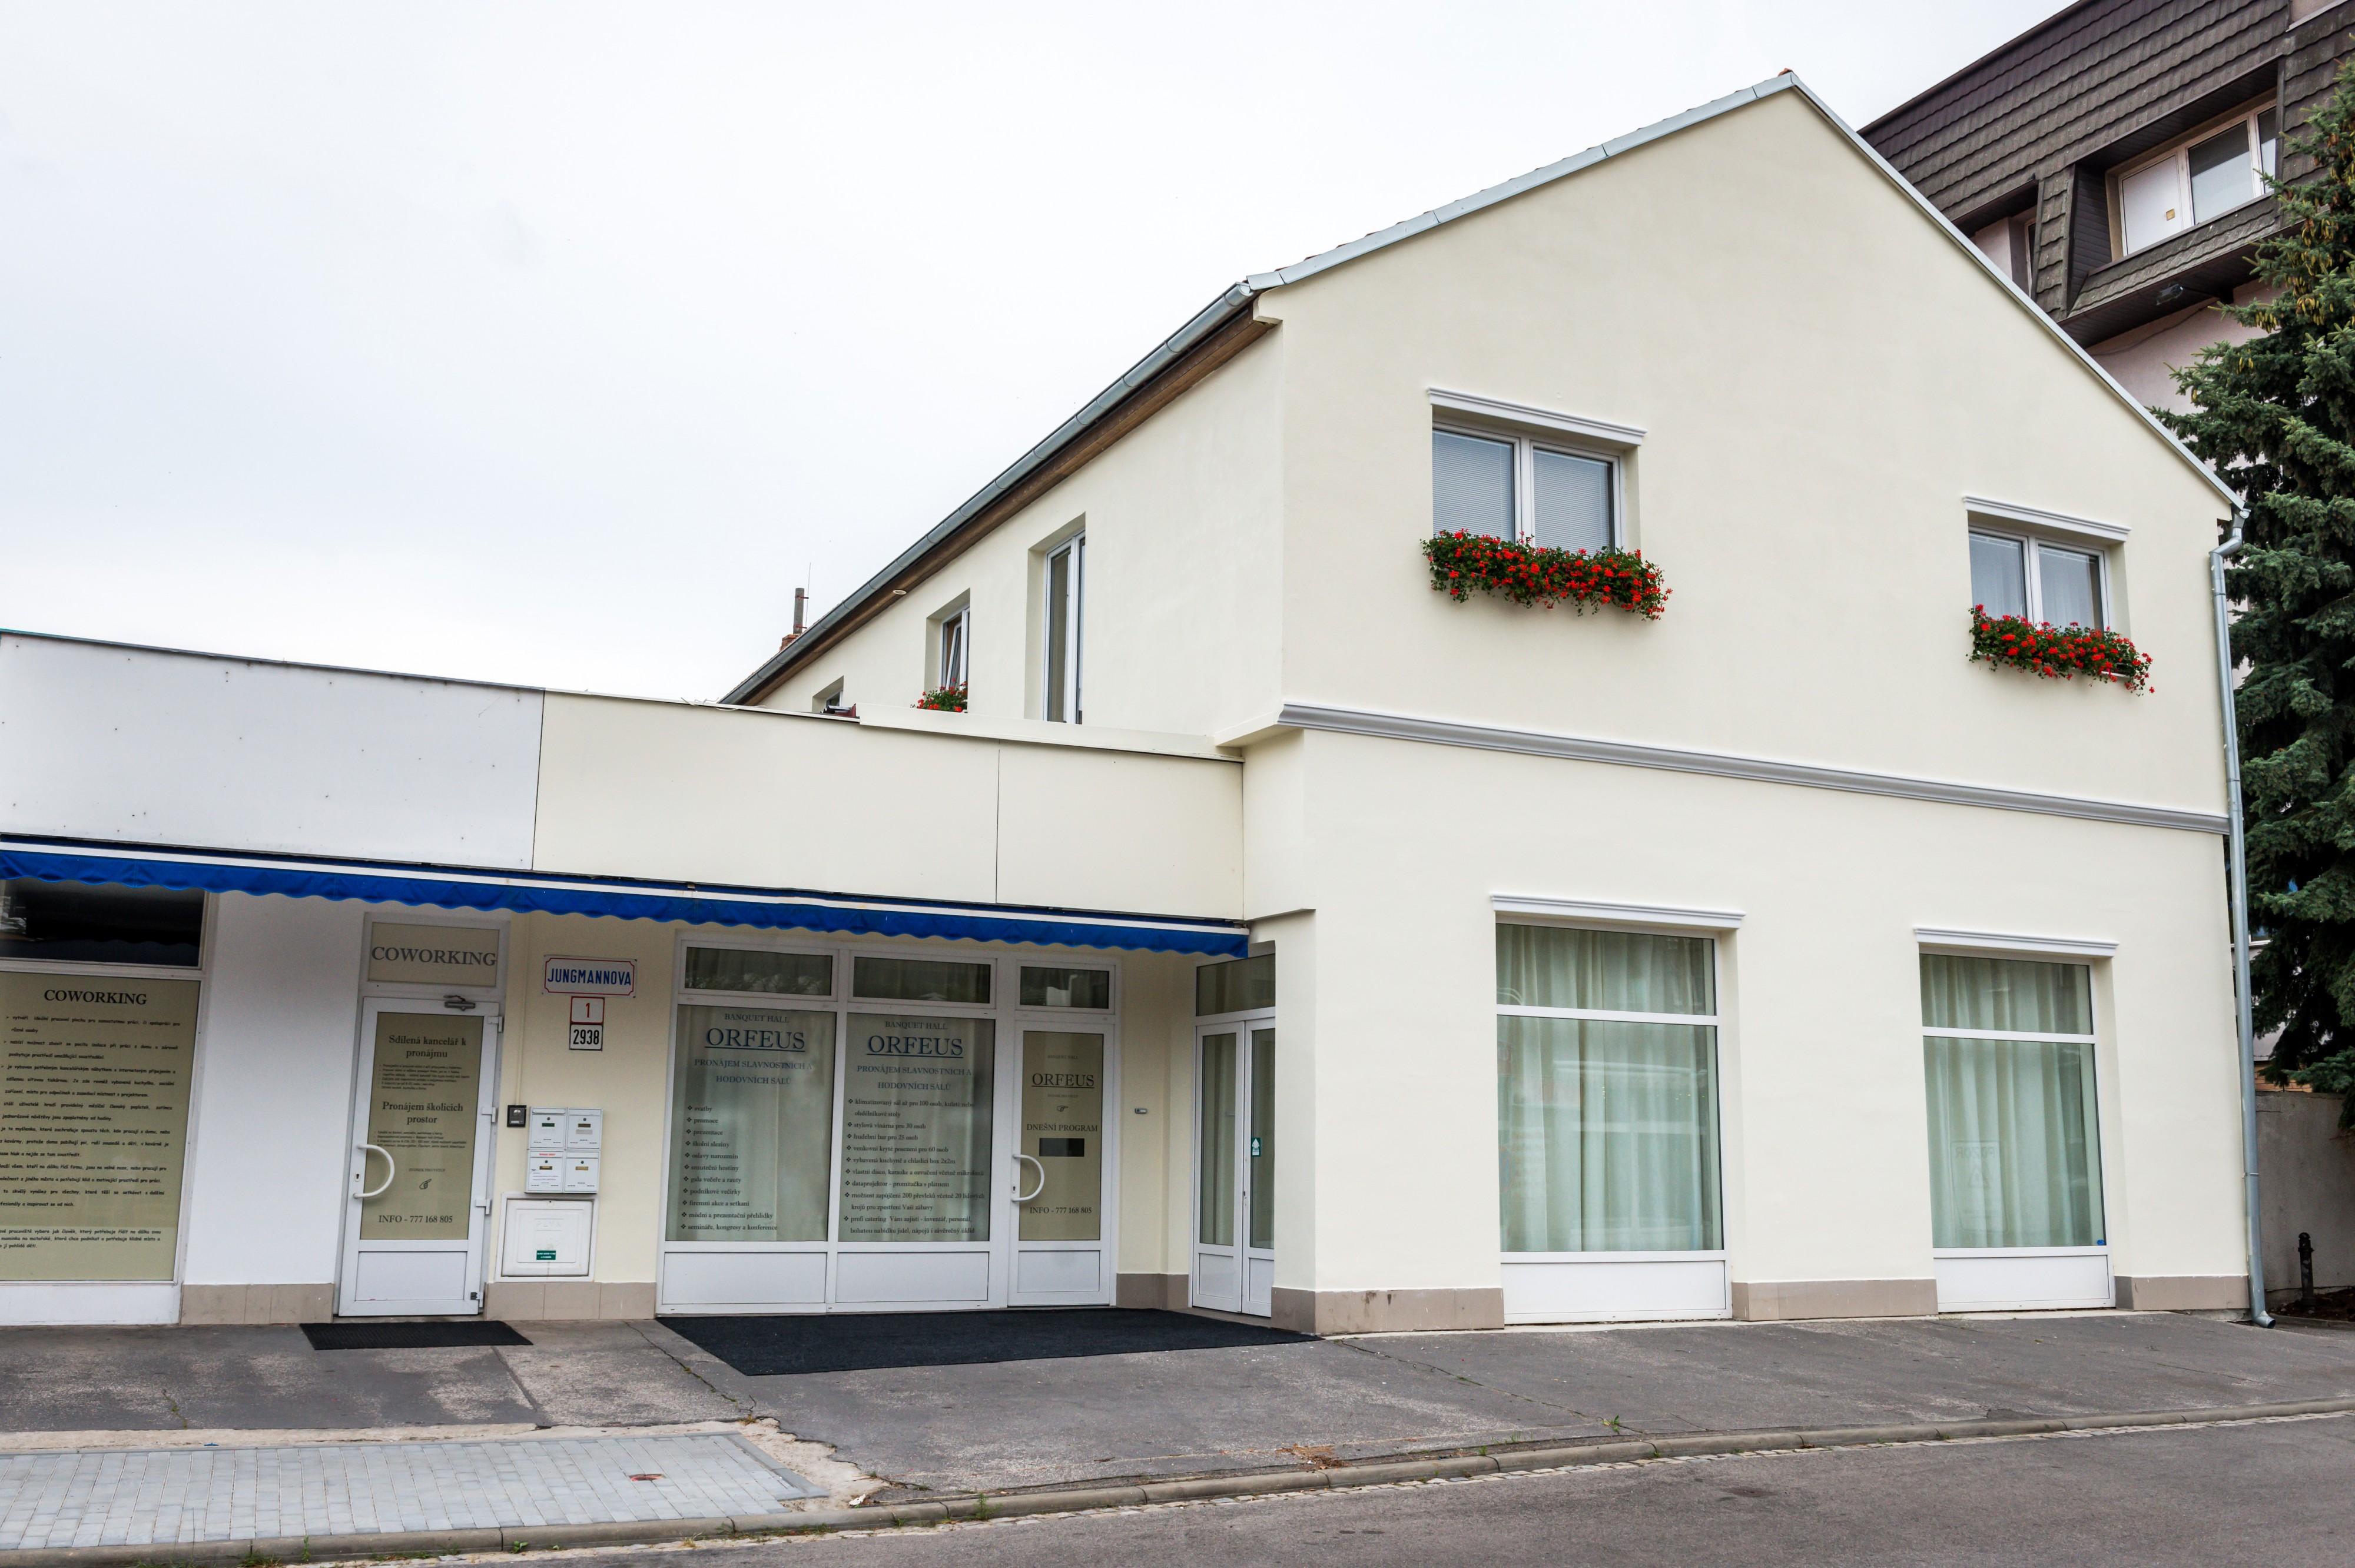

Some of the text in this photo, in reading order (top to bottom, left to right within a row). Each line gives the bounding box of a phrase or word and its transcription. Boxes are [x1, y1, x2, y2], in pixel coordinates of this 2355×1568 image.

[372, 946, 496, 966] COWORKING
[548, 968, 631, 985] JUNGMANNOVA
[44, 989, 147, 1005] COWORKING
[585, 1002, 590, 1018] 1
[725, 1014, 765, 1022] BANQUET
[885, 1021, 924, 1029] BANQUET
[389, 1035, 466, 1046] Sdílená kancelář k
[573, 1029, 599, 1045] 2938
[706, 1028, 805, 1049] ORFEUS
[868, 1035, 963, 1055] ORFEUS
[406, 1049, 447, 1059] pronájmu
[694, 1059, 739, 1068] PRONÁJEM
[857, 1065, 900, 1074] PRONÁJEM
[1032, 1073, 1094, 1087] ORFEUS
[878, 1081, 928, 1089] HODOVNÍCH
[383, 1102, 424, 1112] Pronájem
[694, 1105, 712, 1113] svatby
[930, 1100, 944, 1109] osob,
[888, 1110, 900, 1118] stoly
[407, 1115, 437, 1124] prostor
[692, 1152, 708, 1160] oslavy
[719, 1164, 739, 1172] hostiny
[872, 1168, 886, 1177] disco,
[852, 1180, 887, 1188] dataprojektor
[851, 1215, 863, 1223] profi
[717, 1223, 741, 1231] kongresy
